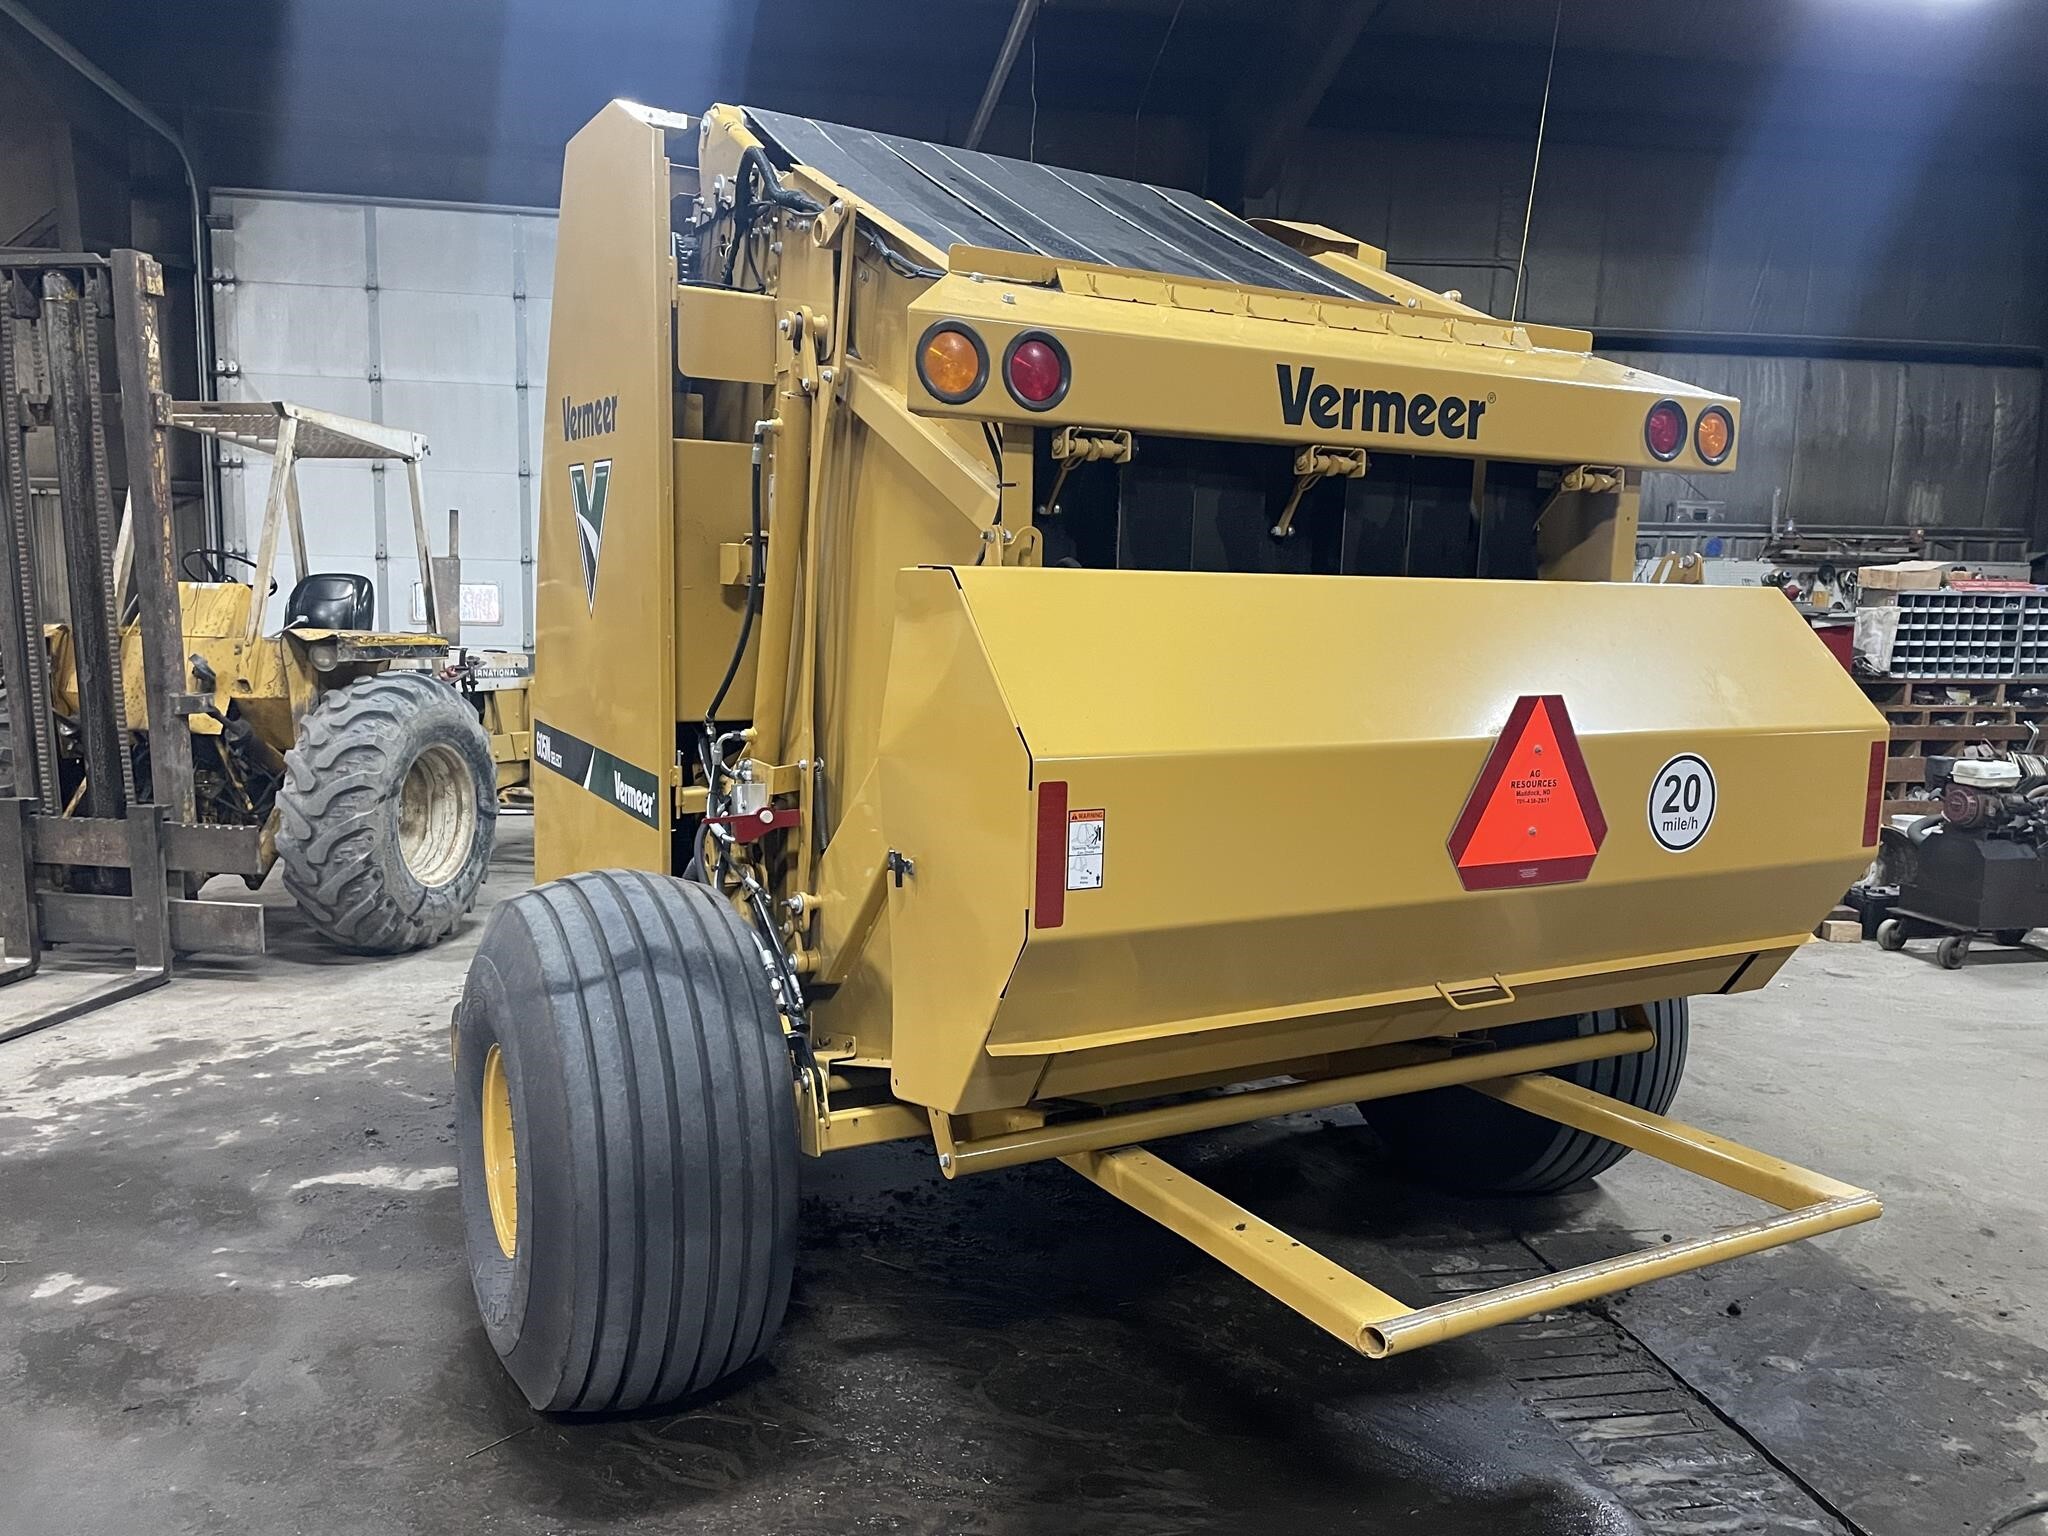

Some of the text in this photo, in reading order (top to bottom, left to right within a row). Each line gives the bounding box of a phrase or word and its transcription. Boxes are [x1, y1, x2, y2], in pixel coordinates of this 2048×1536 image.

[562, 395, 618, 442] Vermeer
[1529, 769, 1541, 778] AG
[1511, 779, 1558, 789] RESOURCES
[1661, 773, 1702, 814] 20
[1078, 811, 1103, 820] WARNING
[1662, 816, 1698, 832] mile/h
